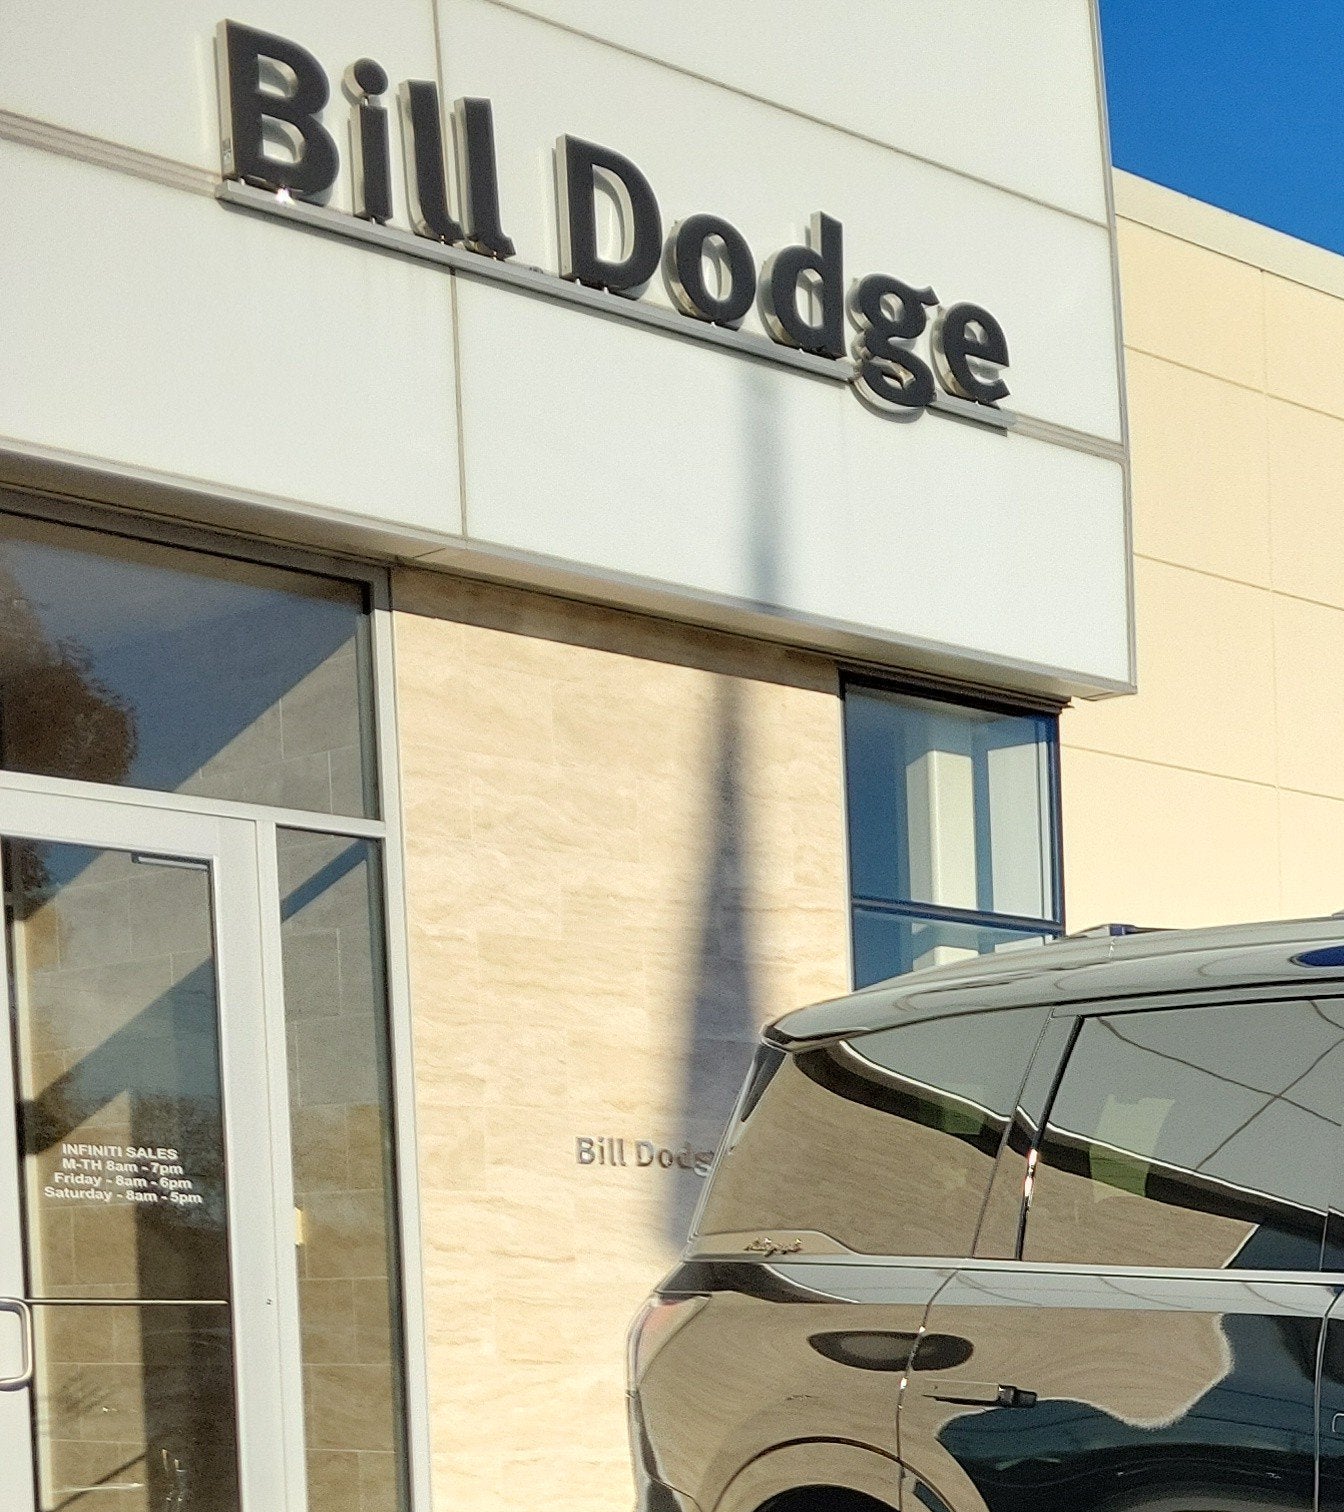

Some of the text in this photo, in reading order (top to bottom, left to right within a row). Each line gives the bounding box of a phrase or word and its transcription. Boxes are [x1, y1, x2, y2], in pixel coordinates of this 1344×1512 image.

[217, 18, 1011, 418] Bill Dodge
[62, 1143, 179, 1160] INFINITI SALES
[575, 1137, 715, 1177] Bill Dodg
[62, 1158, 102, 1170] M-TH
[106, 1161, 139, 1173] 8am
[151, 1162, 183, 1175] 7pm
[54, 1172, 102, 1187] Friday
[115, 1175, 147, 1188] 8am
[160, 1177, 192, 1190] 6pm
[45, 1186, 112, 1202] Saturday
[126, 1190, 158, 1202] 8am
[170, 1191, 203, 1205] 5pm
